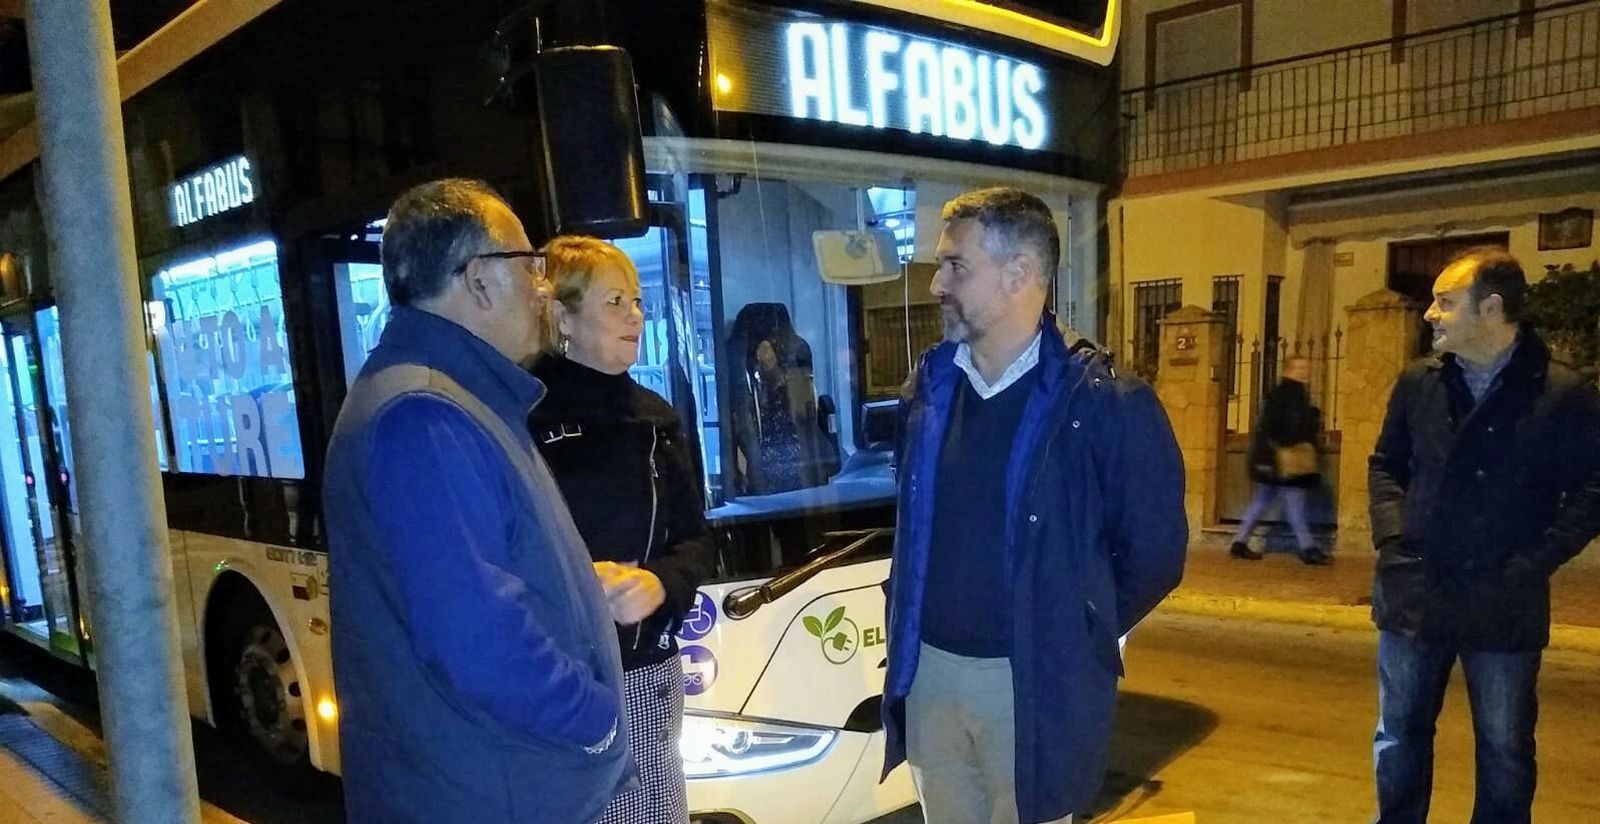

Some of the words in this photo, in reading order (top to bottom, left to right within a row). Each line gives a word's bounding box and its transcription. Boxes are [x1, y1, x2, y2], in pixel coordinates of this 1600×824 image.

[785, 21, 1047, 150] ALFABUS
[174, 156, 254, 227] ALFABUS
[863, 626, 886, 648] EL
